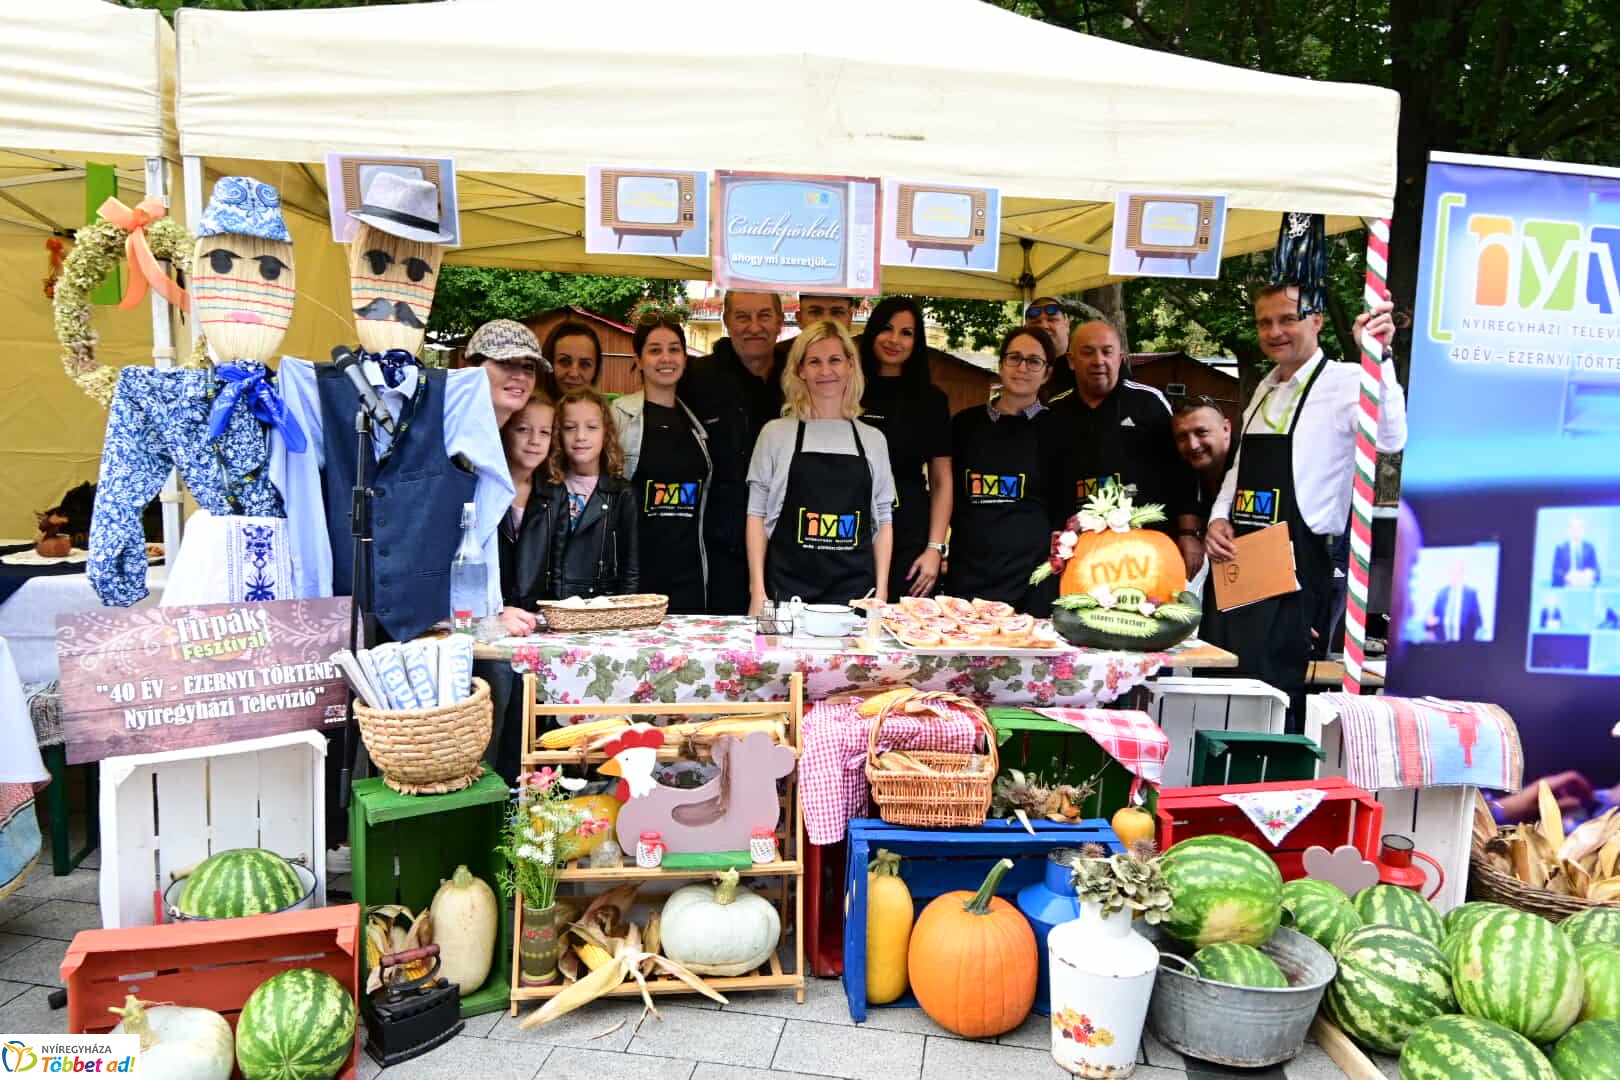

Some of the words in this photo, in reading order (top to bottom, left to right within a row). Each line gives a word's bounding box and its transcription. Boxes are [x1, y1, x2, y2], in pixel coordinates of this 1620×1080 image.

[731, 254, 764, 267] ahogy
[766, 255, 778, 265] mi
[1451, 347, 1470, 361] 40
[1473, 344, 1493, 361] ÉV
[1508, 351, 1570, 367] EZERNYI
[172, 607, 260, 643] Tirpák
[182, 631, 265, 661] Fesztivál
[140, 676, 164, 700] ÉV
[183, 669, 256, 695] EZERNYI
[124, 696, 235, 730] Nyíregyházi
